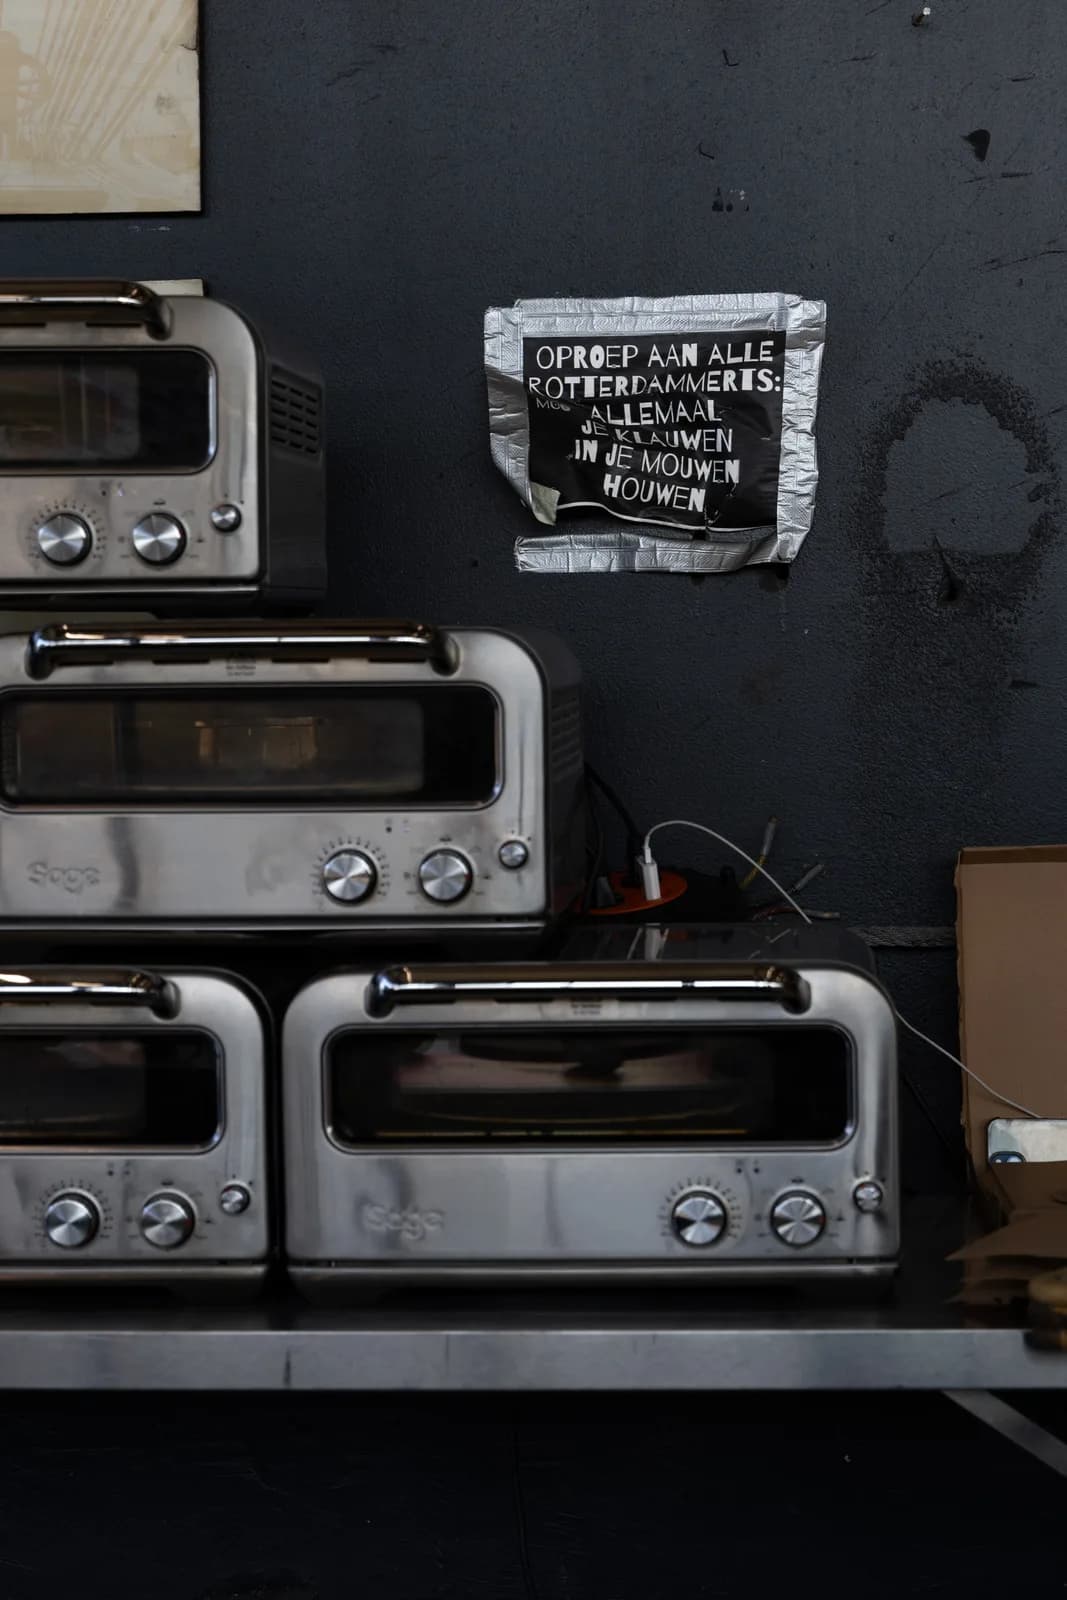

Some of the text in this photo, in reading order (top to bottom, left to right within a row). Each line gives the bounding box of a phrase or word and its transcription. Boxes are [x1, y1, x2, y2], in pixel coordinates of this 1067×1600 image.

[536, 340, 775, 369] OPROEP AAN ALLE
[528, 368, 781, 400] ROTTERDAMMERTS:
[591, 400, 722, 426] ALLEMAAL
[581, 420, 733, 452] JE KLAUWEN
[574, 439, 740, 483] IN JE MOUWEN
[603, 473, 706, 512] HOUWEN
